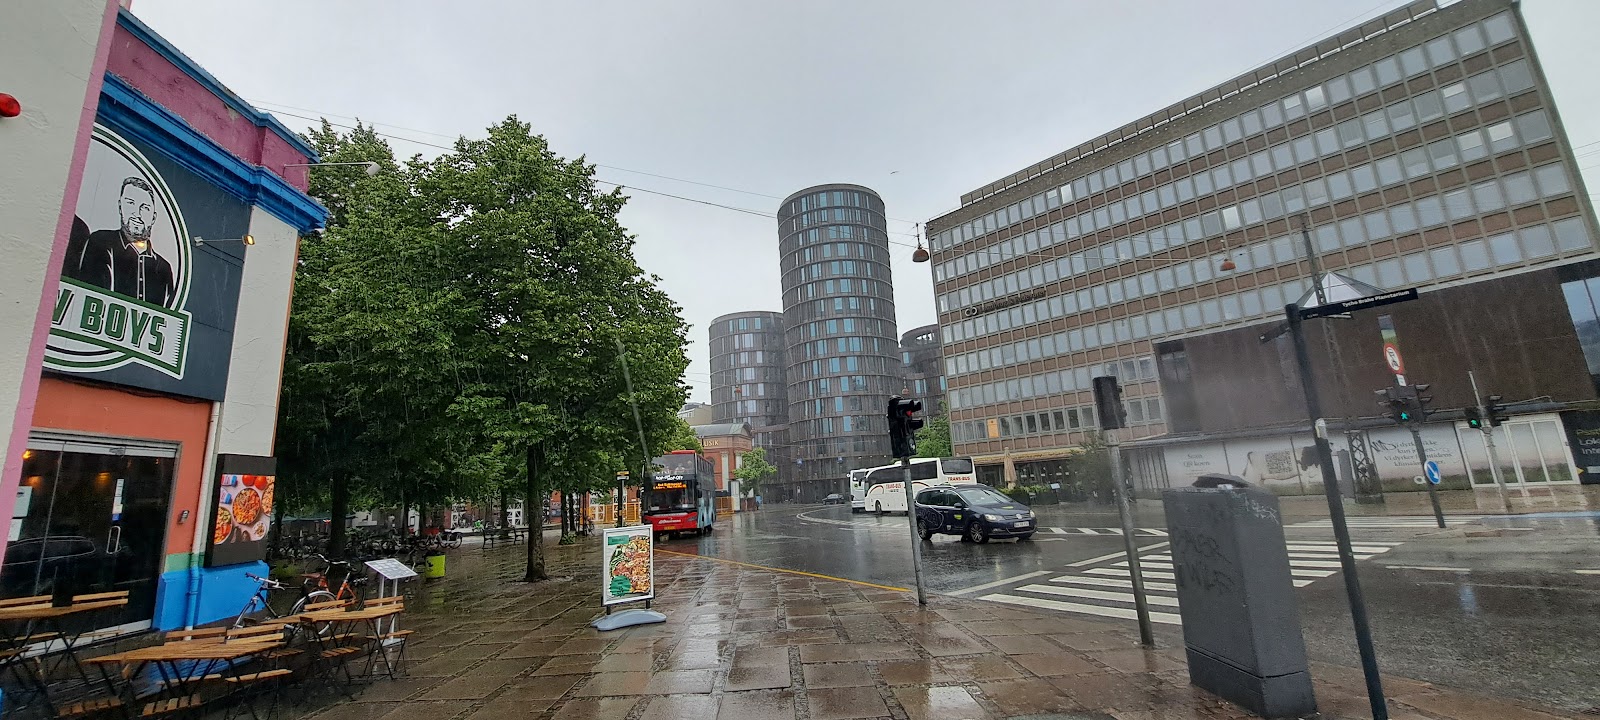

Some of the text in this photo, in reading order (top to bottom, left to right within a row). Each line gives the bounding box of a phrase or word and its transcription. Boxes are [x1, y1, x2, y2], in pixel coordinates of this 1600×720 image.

[1374, 290, 1410, 301] Planetarium
[79, 294, 167, 356] BOYS
[702, 439, 719, 447] USIK
